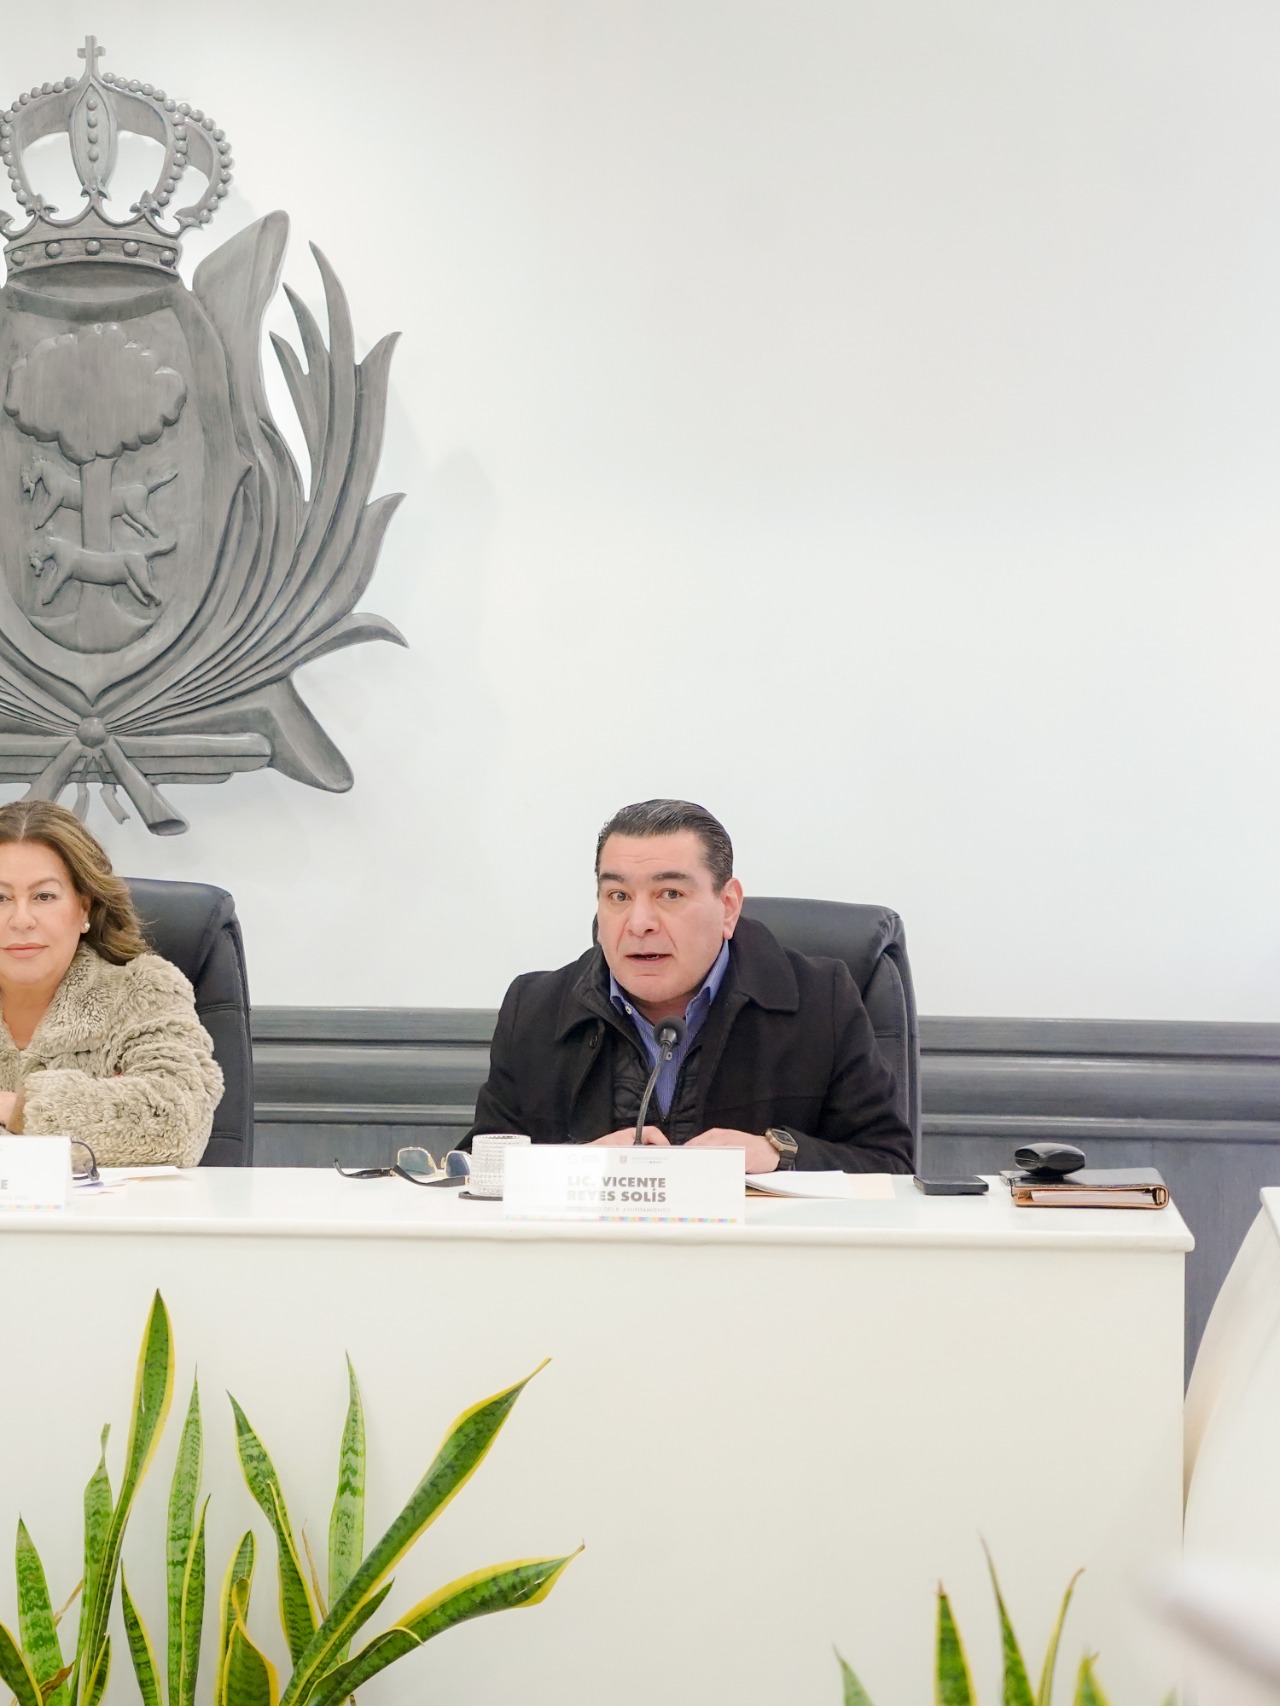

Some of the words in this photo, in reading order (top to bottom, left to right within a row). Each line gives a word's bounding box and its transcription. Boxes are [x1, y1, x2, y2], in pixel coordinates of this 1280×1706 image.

[567, 1176, 596, 1188] LIC.
[602, 1177, 666, 1188] VICENTE
[567, 1189, 616, 1202] REYES
[621, 1187, 667, 1203] SOLÍS
